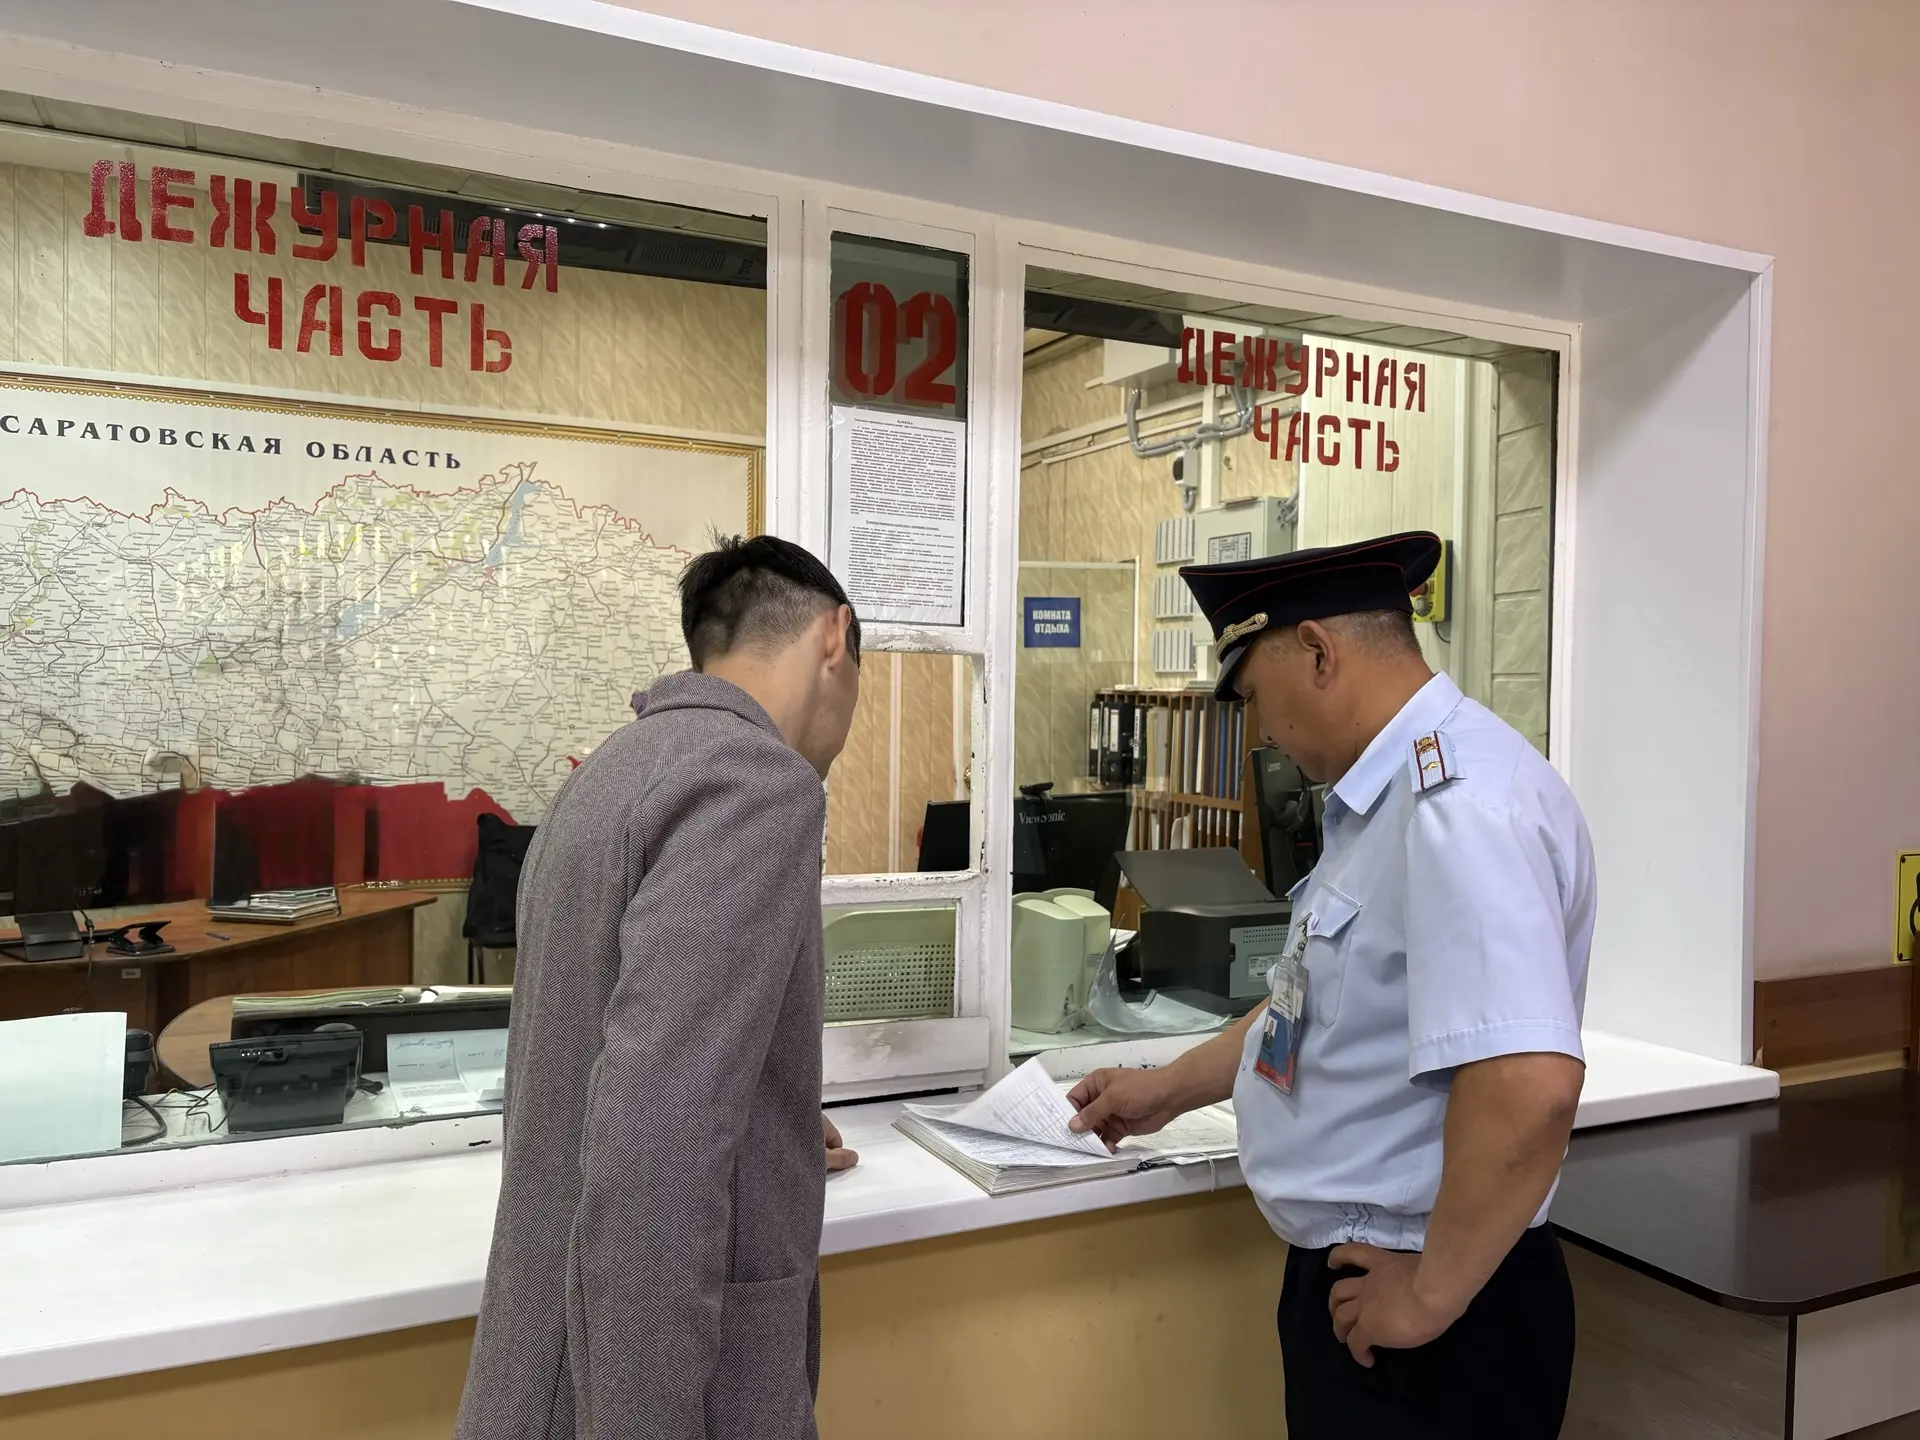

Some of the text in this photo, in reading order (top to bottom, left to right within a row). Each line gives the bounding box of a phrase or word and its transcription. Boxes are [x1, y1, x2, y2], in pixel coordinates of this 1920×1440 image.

[84, 160, 558, 293] ДЕЖУРНАЯ
[234, 273, 513, 374] ЧАСТЬ
[845, 281, 958, 404] 02
[1177, 326, 1426, 412] ДЕЖУРНАЯ
[0, 415, 461, 470] САРАТОВСКАЯ ОБЛАСТЬ
[1253, 406, 1400, 473] ЧАСТЬ
[1032, 609, 1072, 621] КОМНАТА
[1034, 622, 1070, 635] ОТДЫХА
